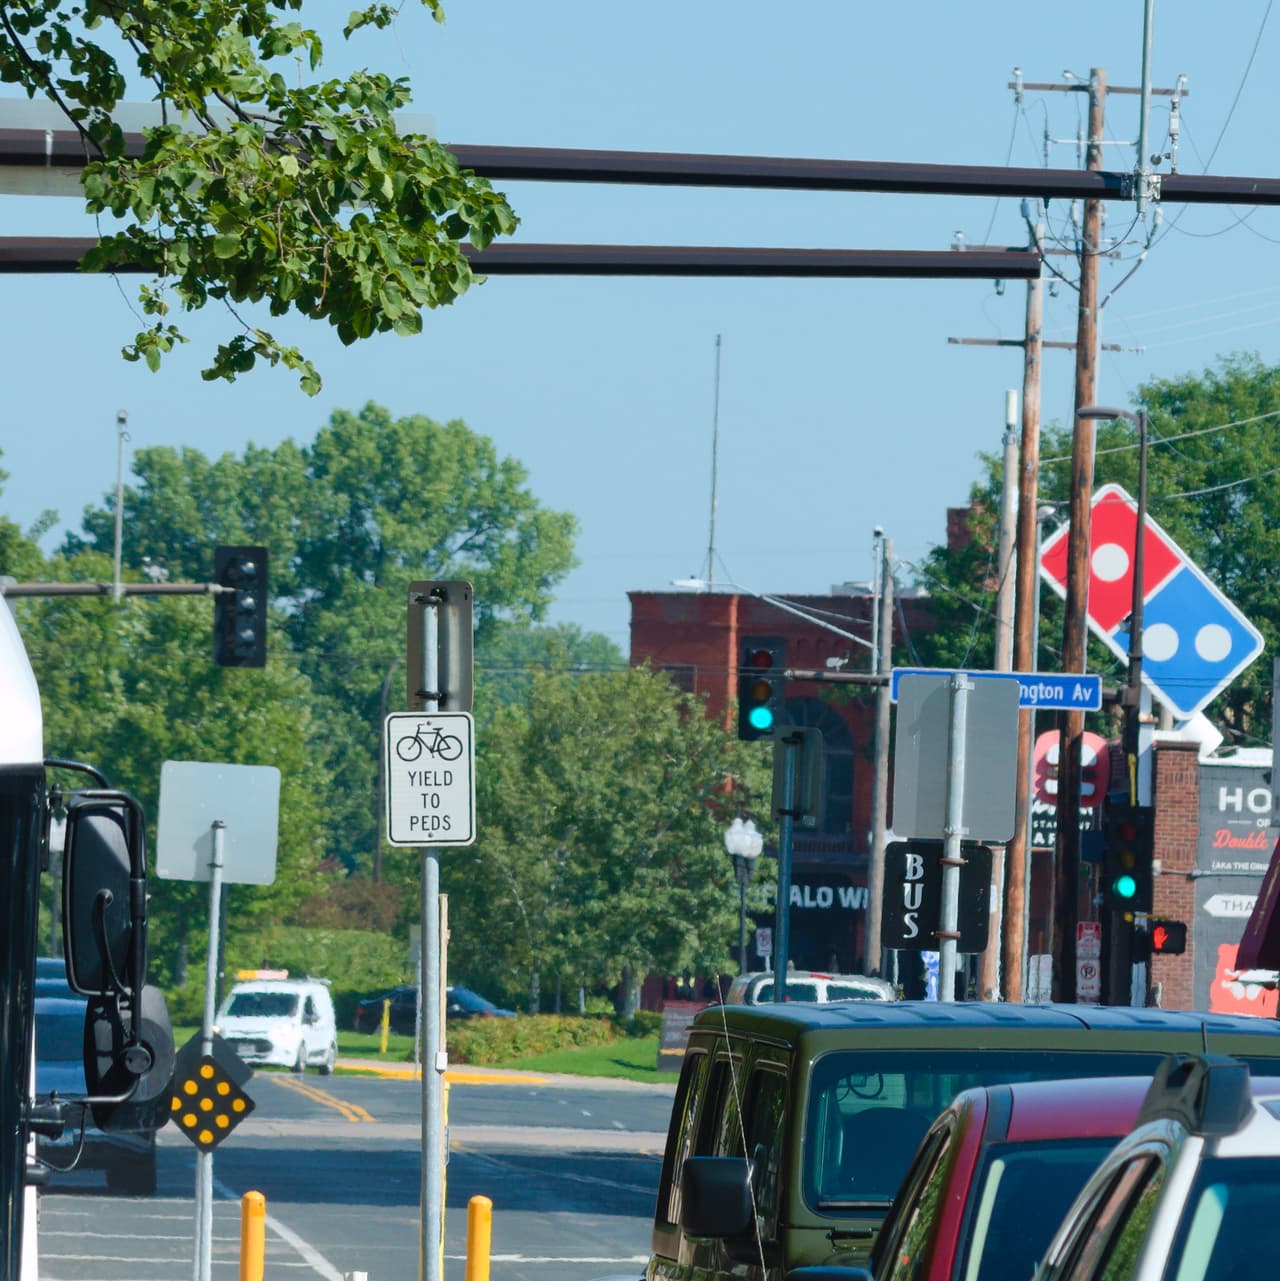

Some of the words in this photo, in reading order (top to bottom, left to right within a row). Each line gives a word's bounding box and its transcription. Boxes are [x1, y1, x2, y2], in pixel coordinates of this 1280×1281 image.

[1020, 685, 1064, 704] ngton
[1072, 683, 1093, 701] Av
[408, 770, 454, 787] YIELD
[421, 793, 440, 809] TO
[1218, 786, 1272, 813] HO
[410, 815, 452, 831] PEDS
[1211, 829, 1269, 849] Double
[903, 853, 924, 939] BUS
